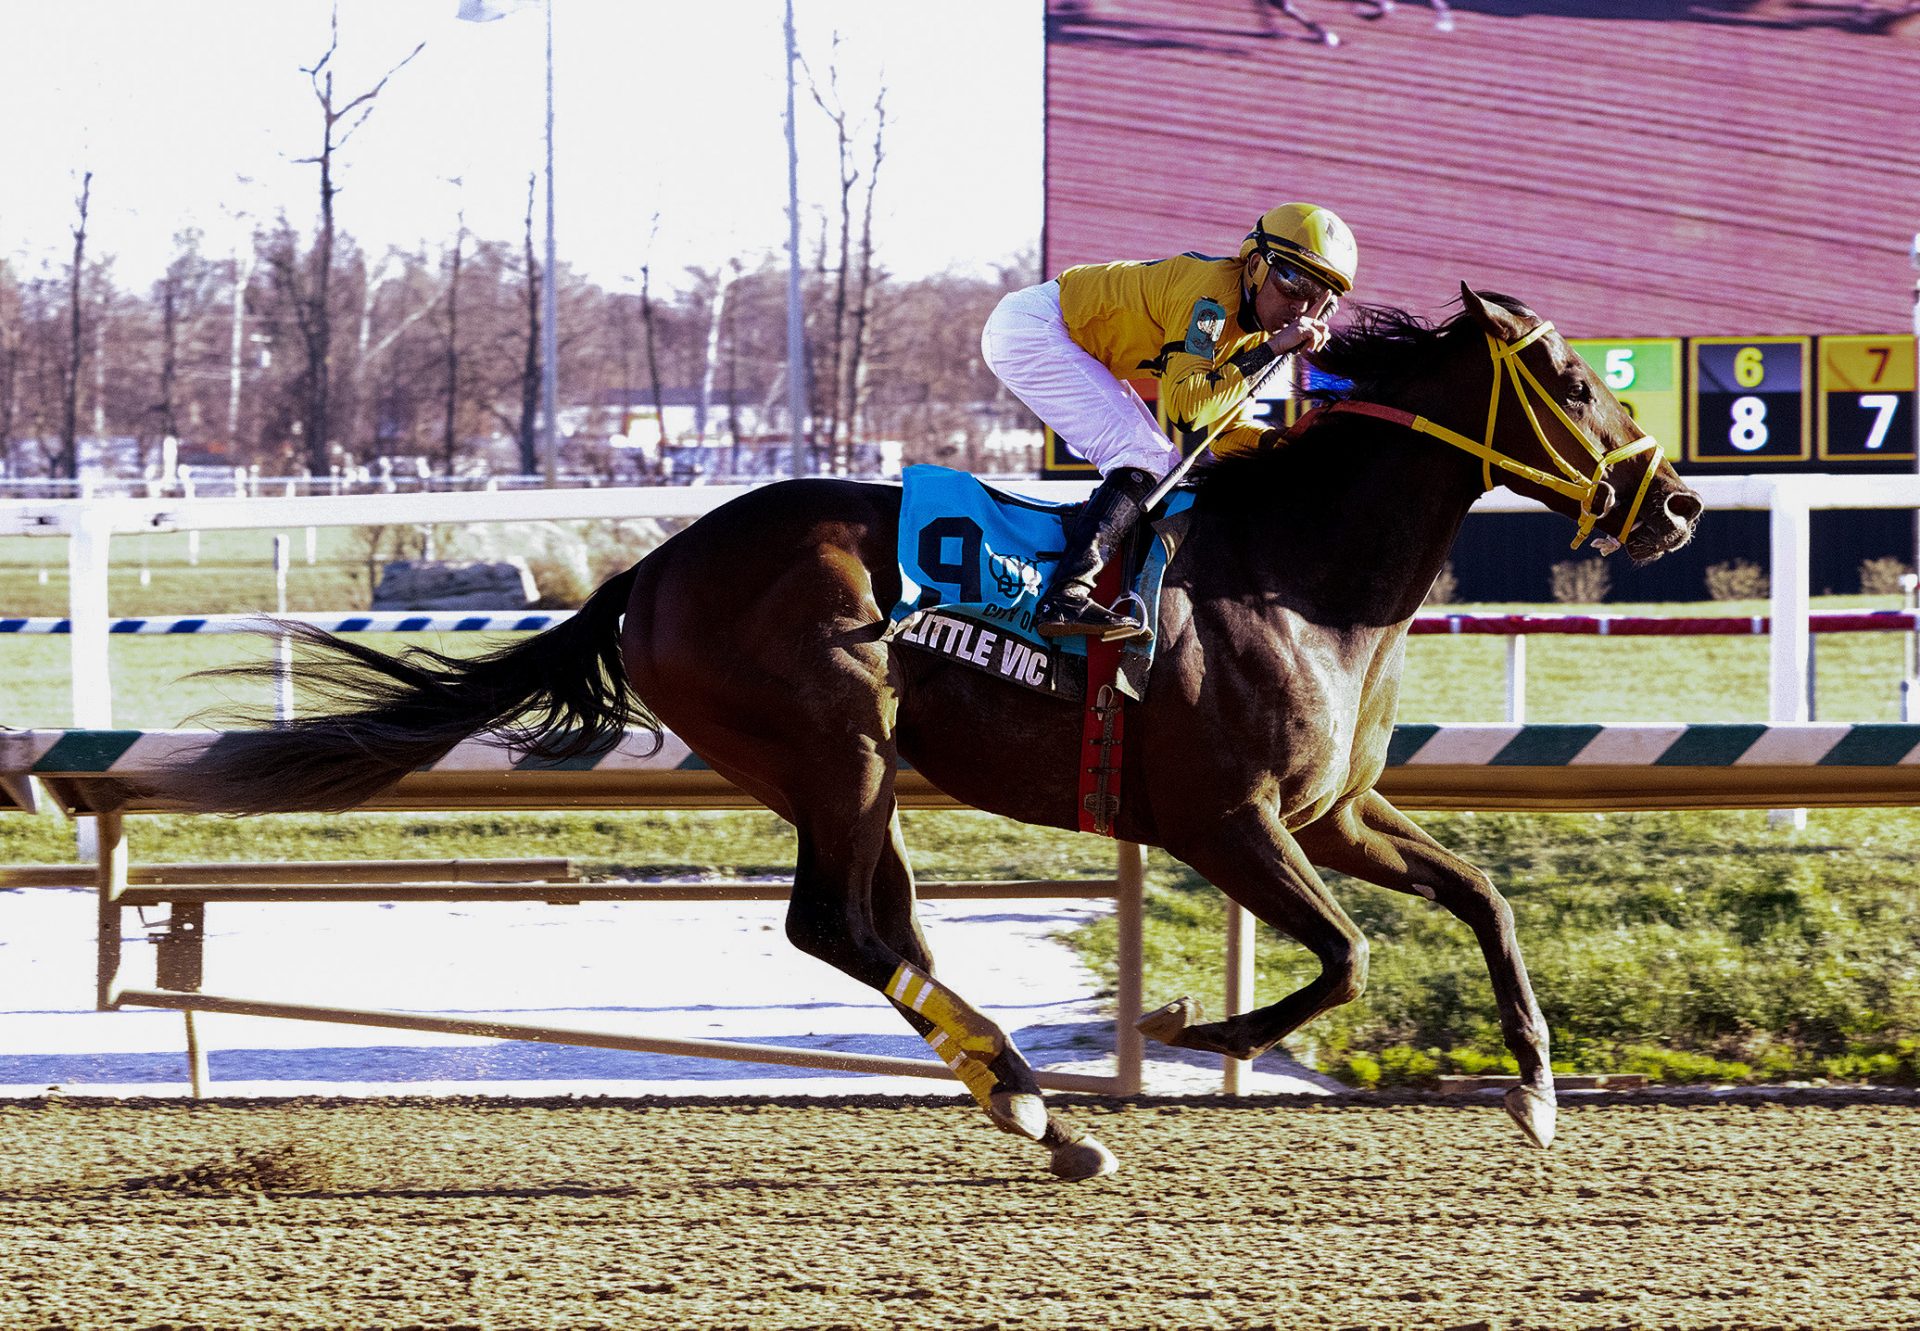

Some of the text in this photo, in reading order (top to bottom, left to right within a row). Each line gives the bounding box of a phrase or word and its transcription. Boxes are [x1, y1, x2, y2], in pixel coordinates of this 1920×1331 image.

[1605, 349, 1635, 389] 5
[1734, 347, 1764, 388] 6
[1868, 348, 1891, 384] 7
[1729, 396, 1769, 451] 8
[1859, 395, 1899, 449] 7
[918, 516, 984, 608] 9
[902, 612, 1048, 687] LITTLE VIC
